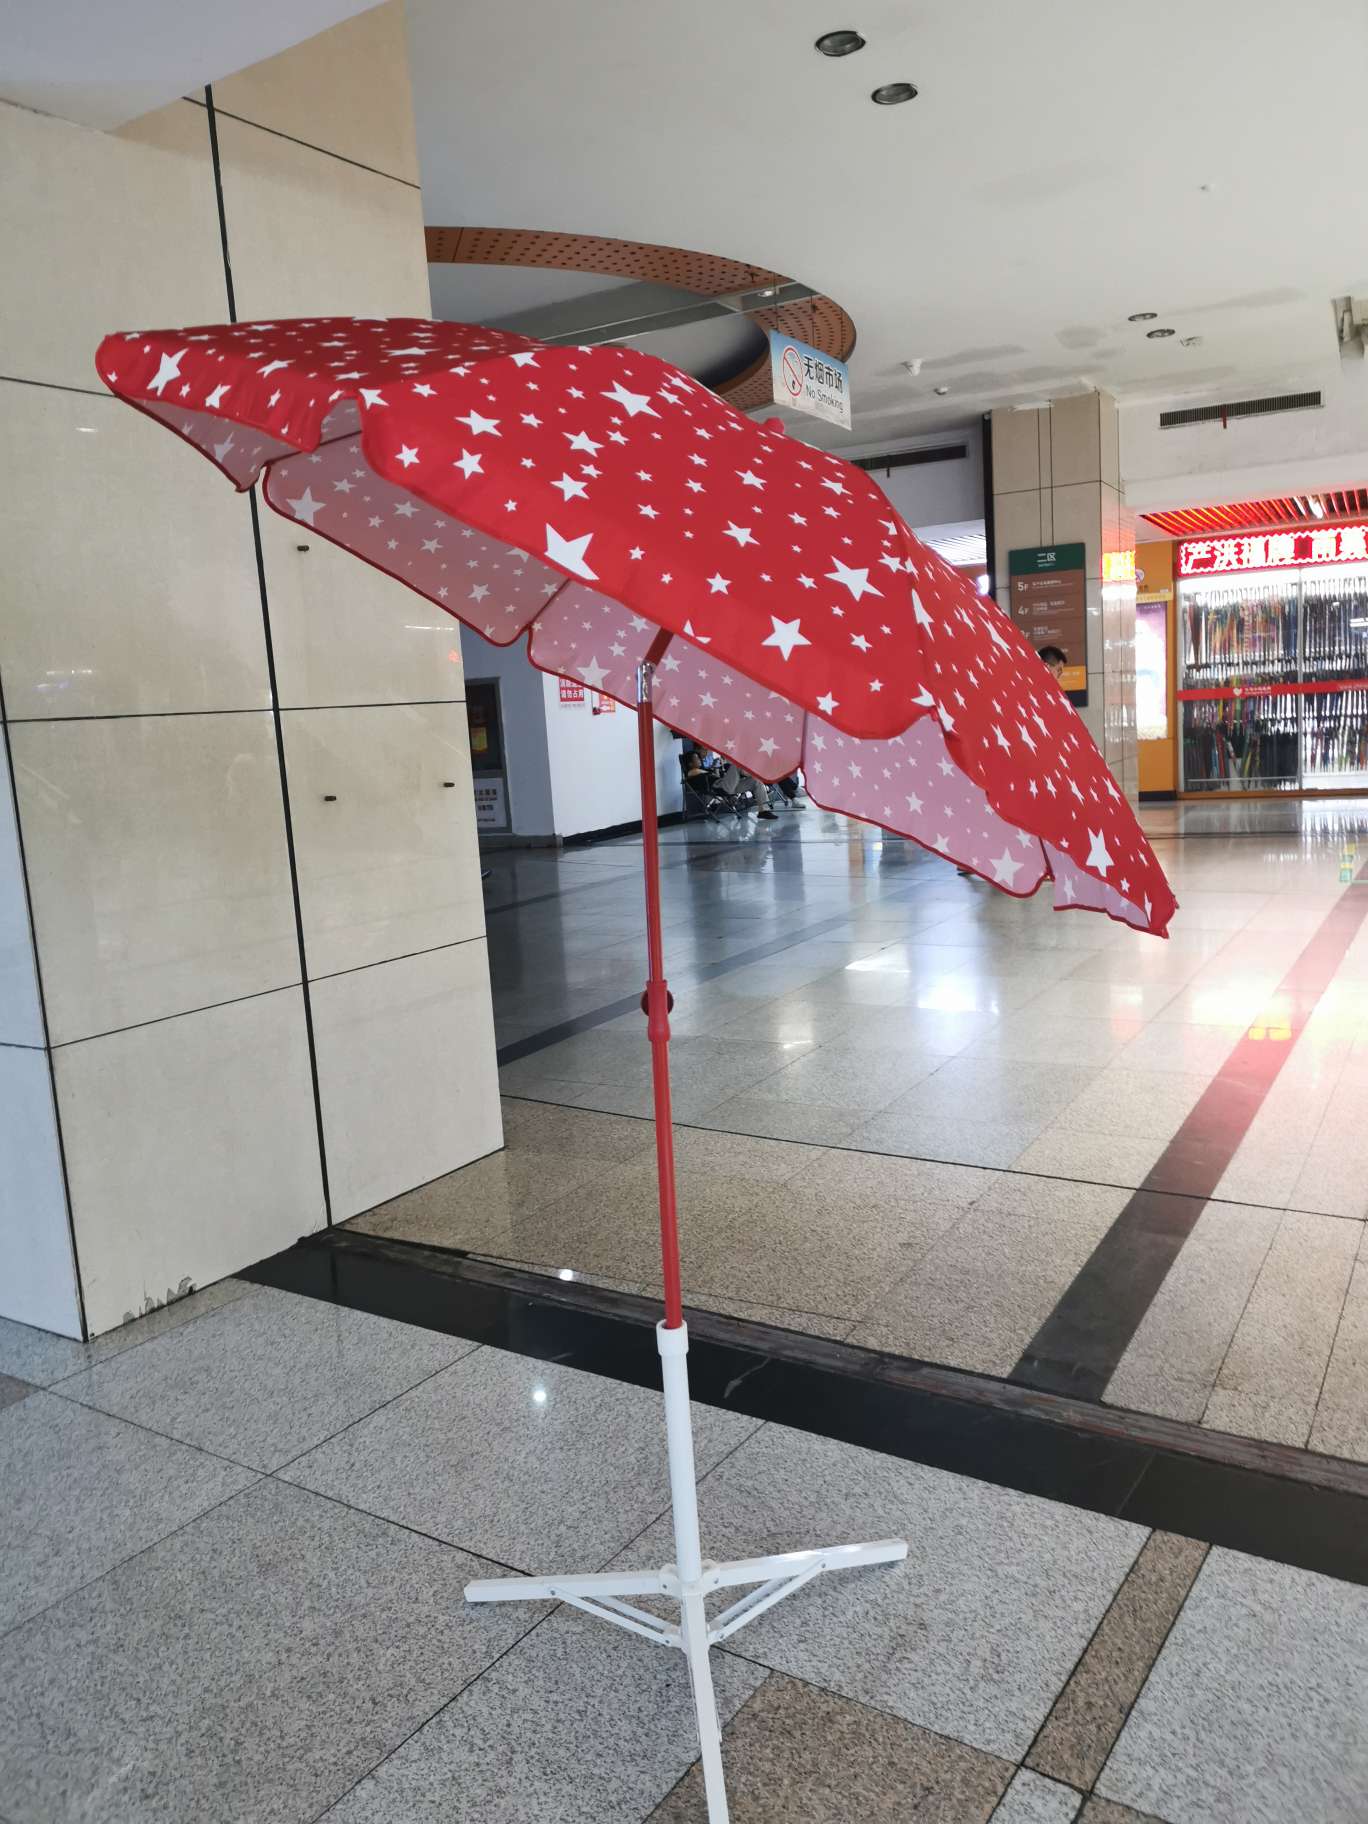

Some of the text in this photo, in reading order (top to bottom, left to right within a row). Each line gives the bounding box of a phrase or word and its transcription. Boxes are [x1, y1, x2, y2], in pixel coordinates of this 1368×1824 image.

[803, 355, 844, 394] 无烟市场
[806, 385, 844, 414] No Smoking
[1037, 552, 1056, 562] 二区
[1017, 581, 1029, 592] 5F
